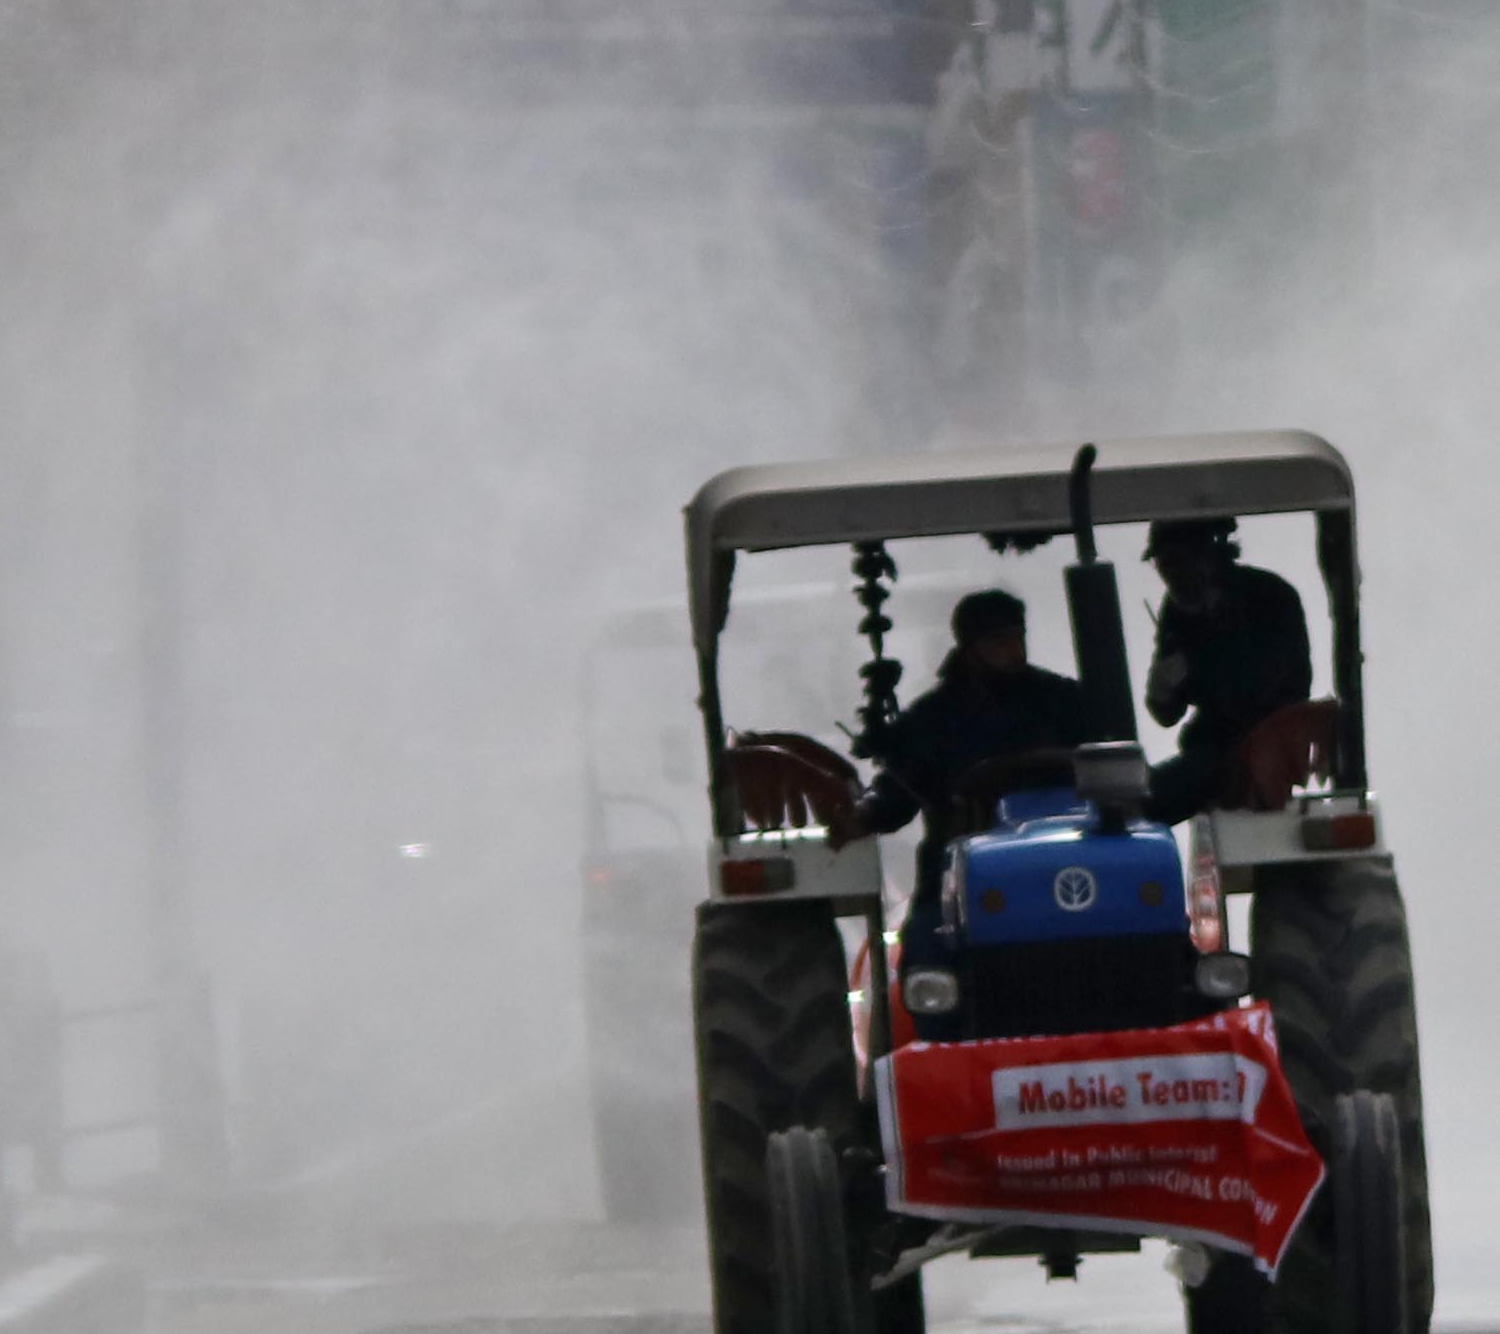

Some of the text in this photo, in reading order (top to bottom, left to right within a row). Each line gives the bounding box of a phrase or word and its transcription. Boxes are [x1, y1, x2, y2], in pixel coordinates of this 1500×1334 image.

[1017, 1073, 1127, 1115] Mobile
[997, 1149, 1056, 1172] Issued
[1087, 1145, 1143, 1165] Public
[1108, 1168, 1213, 1202] MUNICIPAL
